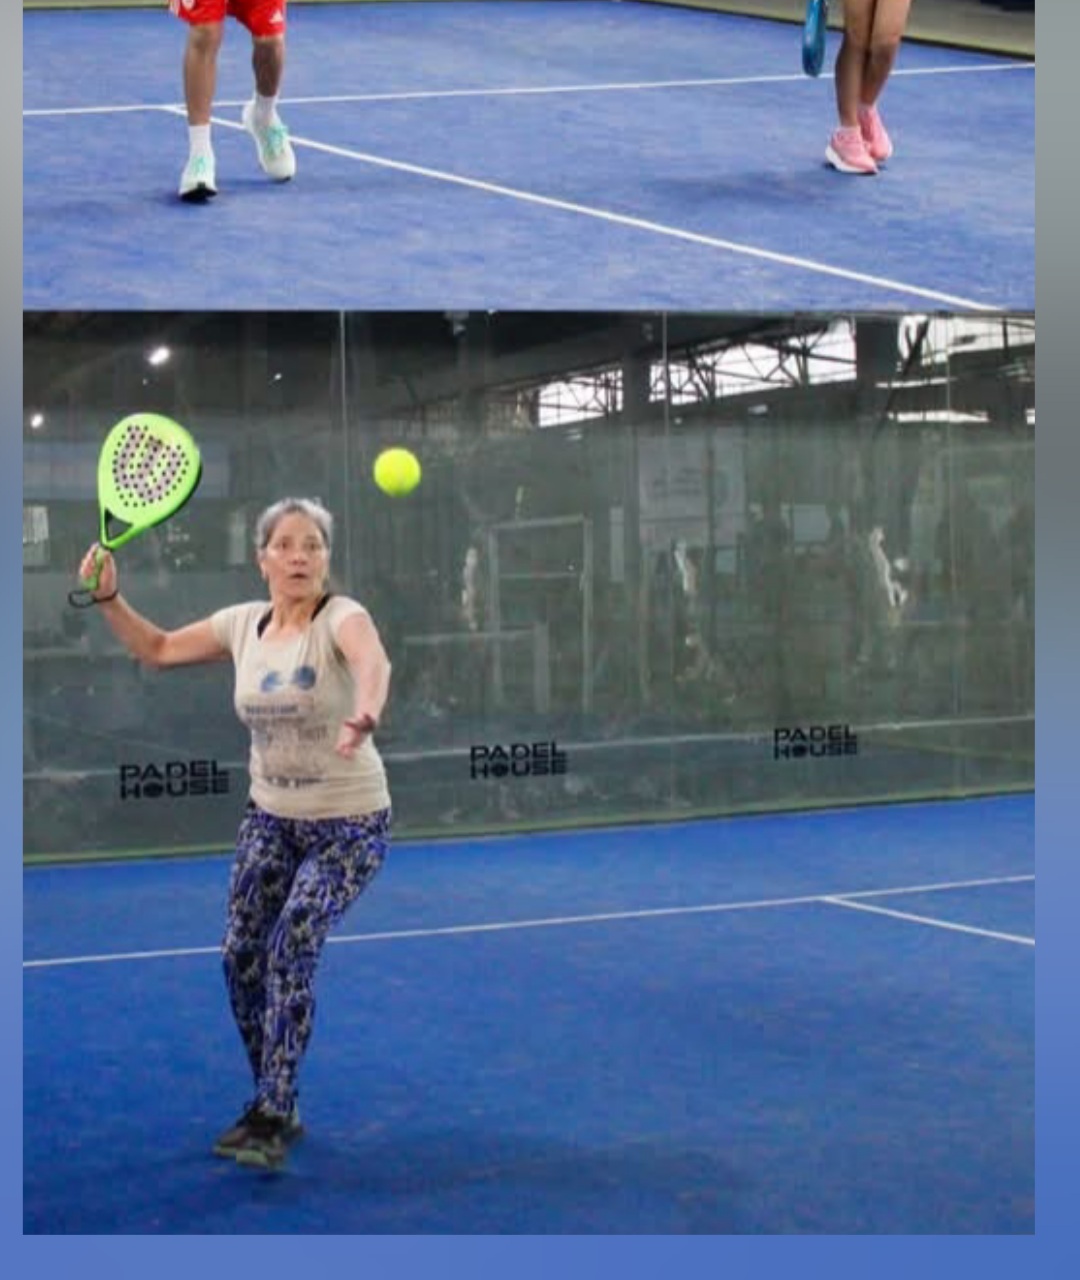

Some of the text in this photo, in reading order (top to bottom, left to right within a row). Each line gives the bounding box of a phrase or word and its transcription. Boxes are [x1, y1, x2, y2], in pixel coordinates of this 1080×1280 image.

[774, 724, 858, 742] PADEL
[471, 741, 568, 760] PADEL
[774, 741, 858, 759] HOUSE
[120, 760, 229, 780] PADEL
[471, 760, 568, 780] HOUSE
[120, 778, 229, 798] HOUSE
